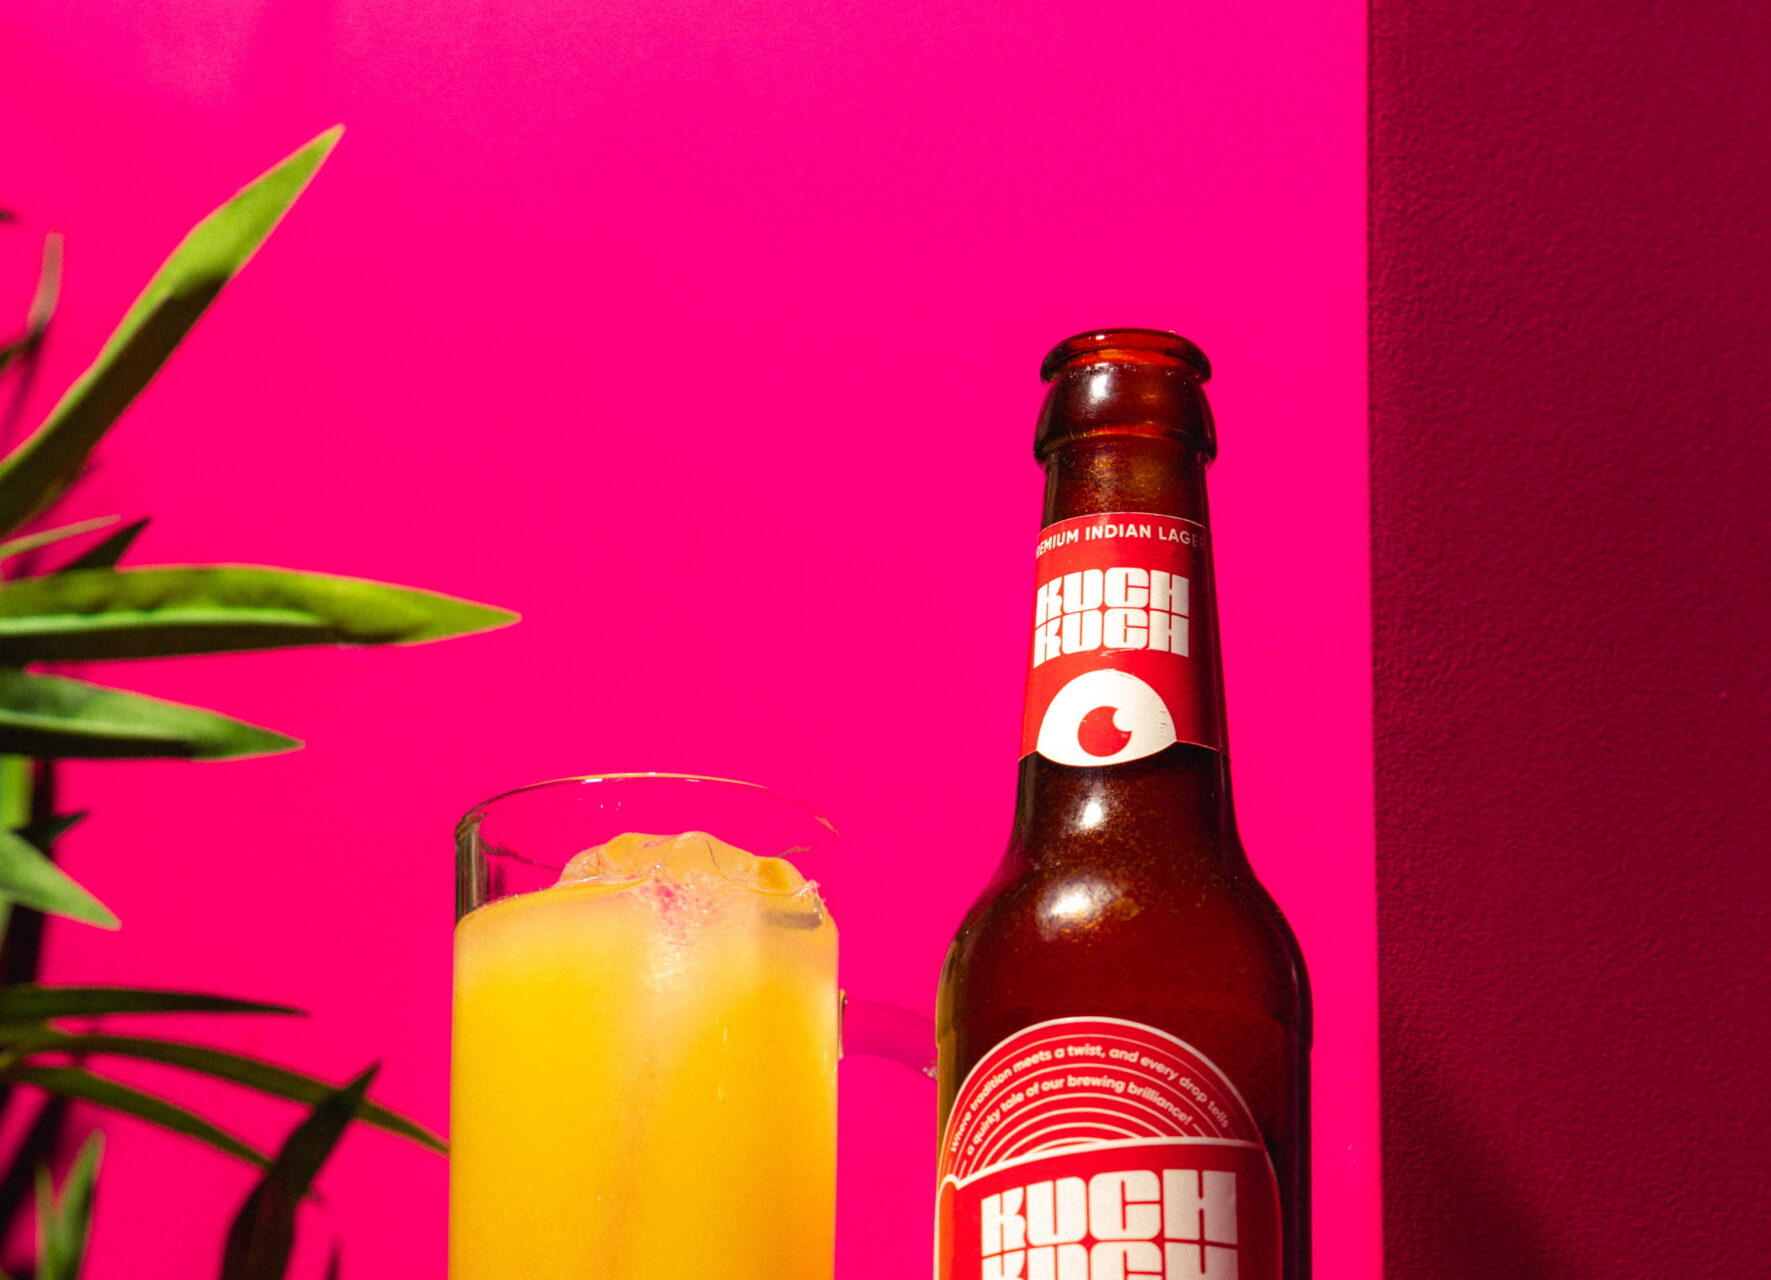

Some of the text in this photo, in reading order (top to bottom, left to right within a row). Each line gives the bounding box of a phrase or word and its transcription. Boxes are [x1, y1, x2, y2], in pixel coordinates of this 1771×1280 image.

[1085, 524, 1151, 541] INDIAN
[1034, 567, 1189, 629] KUCH
[1033, 608, 1189, 669] KUCH
[966, 1075, 1193, 1156] a quirky tale of our brewing brilliance!
[970, 1068, 1012, 1111] tradition
[1012, 1050, 1052, 1073] meets
[1054, 1048, 1065, 1058] a
[1067, 1043, 1106, 1058] twist,
[1108, 1048, 1140, 1063] and
[1140, 1056, 1179, 1081] every
[1179, 1076, 1208, 1103] drop
[1207, 1101, 1230, 1128] tells
[981, 1169, 1238, 1258] KUCH
